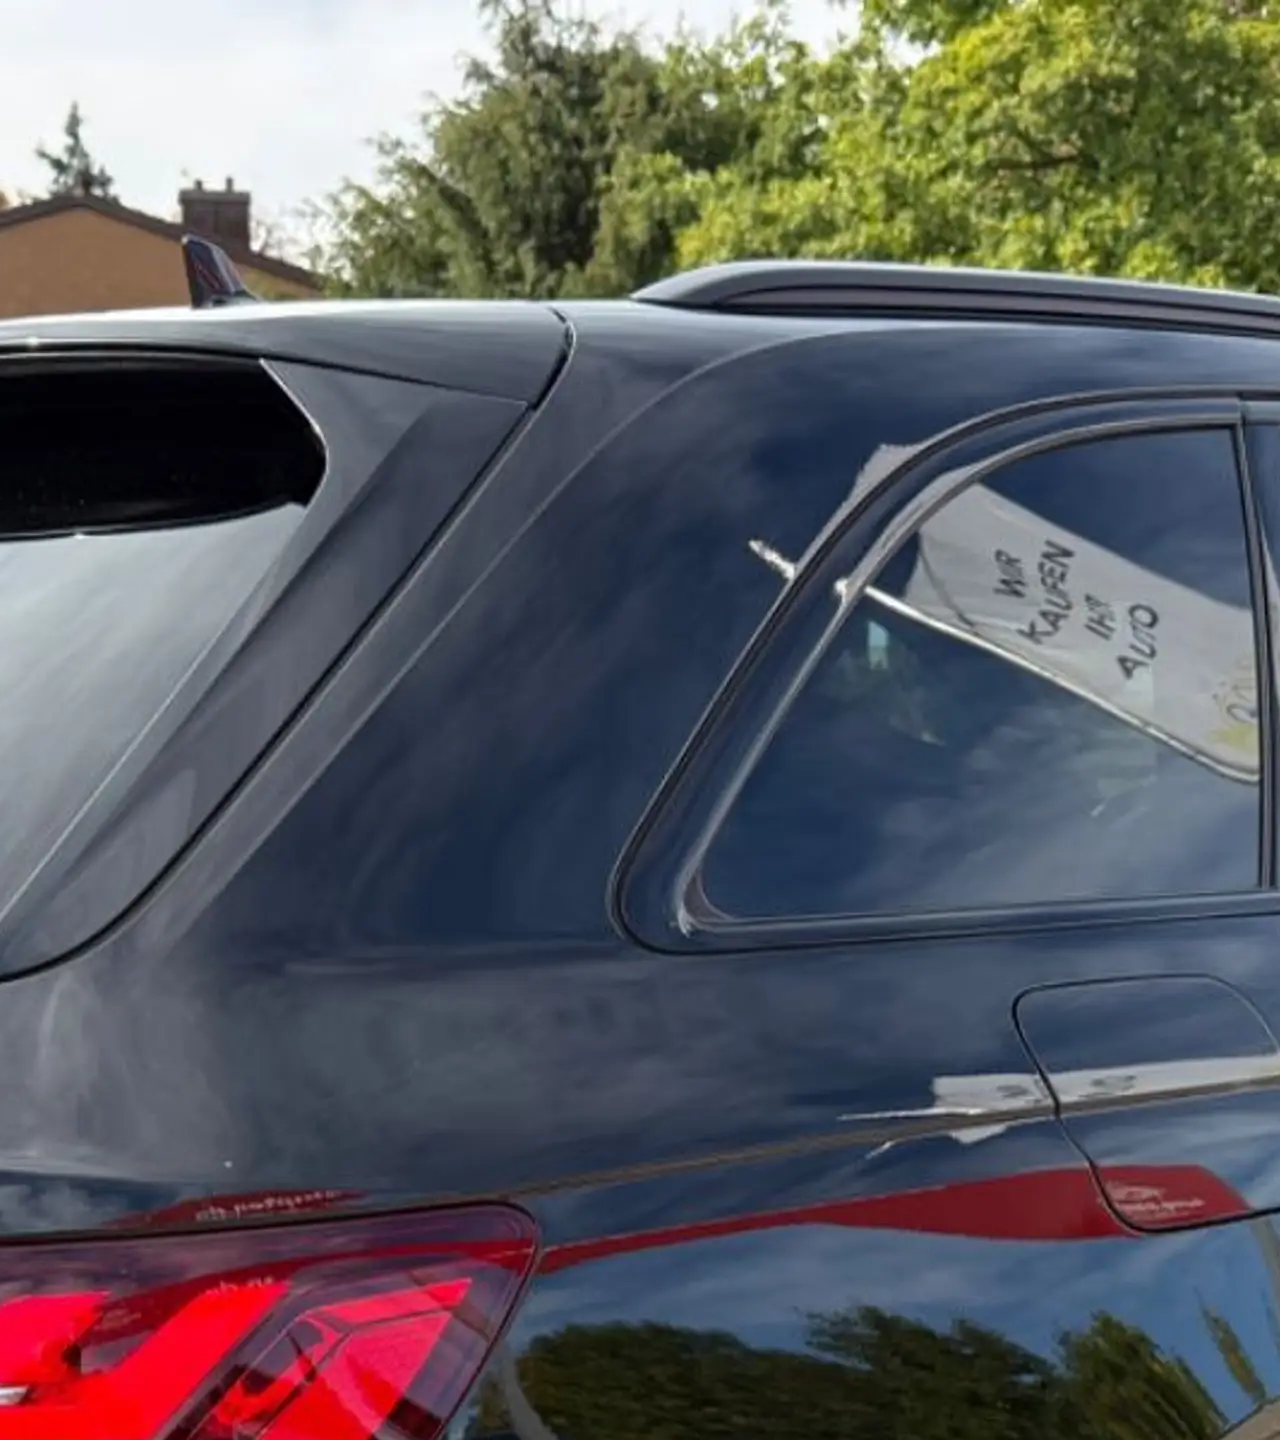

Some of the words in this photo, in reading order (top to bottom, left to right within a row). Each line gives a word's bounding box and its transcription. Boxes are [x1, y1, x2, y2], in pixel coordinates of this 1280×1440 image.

[993, 549, 1026, 599] WIR
[1017, 541, 1076, 645] KAUFEN
[1084, 593, 1117, 641] IHR
[1115, 604, 1160, 680] AUTO
